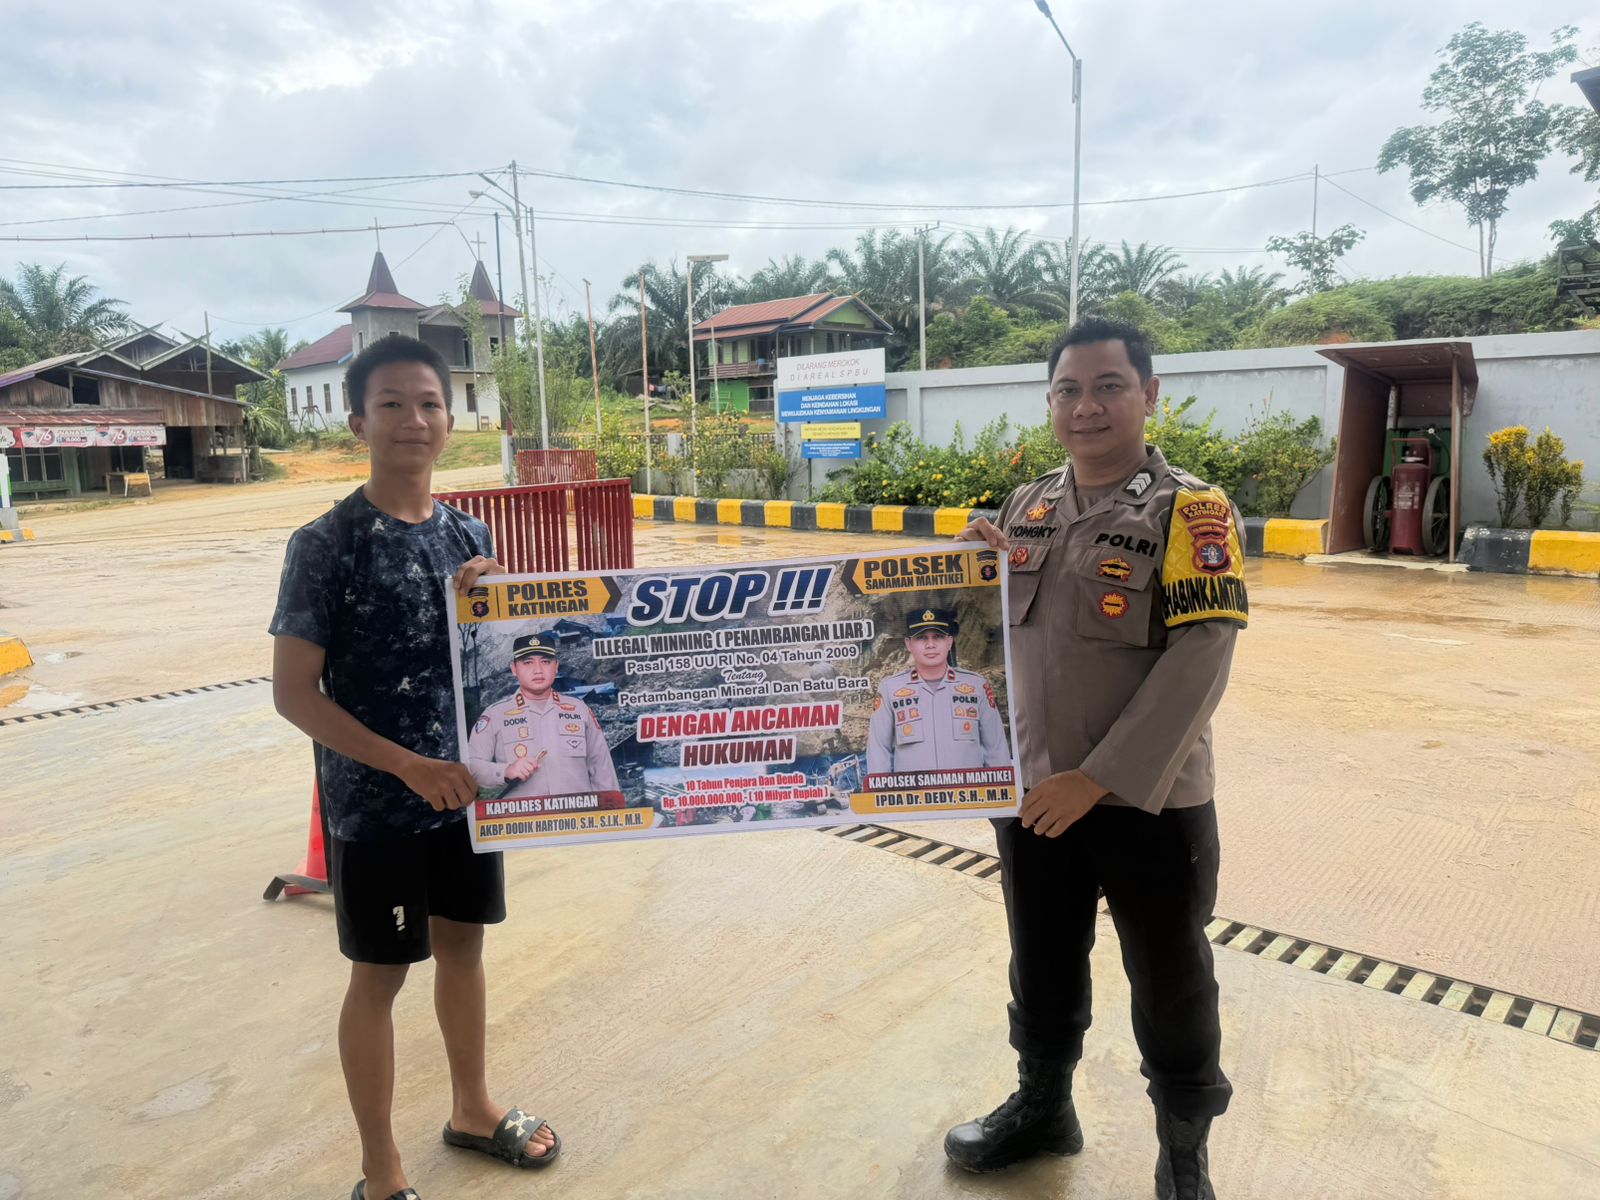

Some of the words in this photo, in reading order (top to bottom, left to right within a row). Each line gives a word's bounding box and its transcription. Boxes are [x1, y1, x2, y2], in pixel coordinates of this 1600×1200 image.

[796, 361, 827, 371] DILARANG
[827, 358, 860, 369] MEROKOK
[802, 371, 836, 380] AREAL
[839, 368, 868, 378] SPBU
[801, 394, 825, 402] MENJAGA
[825, 392, 857, 401] KEBERSIHAN
[848, 406, 881, 414] LINGKUNGAN
[1182, 502, 1226, 515] POLRES
[1009, 525, 1057, 539] YONGKY
[1095, 533, 1158, 558] POLRI
[863, 554, 963, 579] POLSEK
[865, 576, 914, 590] SANAMAN
[916, 572, 964, 587] MANTIKEI
[506, 579, 588, 603] POLRES
[629, 573, 766, 623] STOP
[771, 567, 833, 612] !!!
[508, 599, 590, 617] KATINGAN
[595, 637, 648, 657] ILLEGAL
[650, 632, 713, 653] MINNING
[724, 624, 830, 648] PENAMBANGAN
[832, 622, 864, 640] LIAR
[627, 659, 664, 673] Pasal
[668, 657, 691, 670] 158
[695, 655, 714, 668] UU
[719, 654, 732, 666] RI
[736, 653, 758, 665] No.
[762, 652, 778, 663] 04
[782, 650, 822, 661] Tahun
[826, 646, 857, 659] 2009
[722, 669, 765, 682] Tentang
[620, 689, 717, 705] Pertambangan
[720, 683, 769, 698] Mineral
[773, 682, 799, 693] Dan
[803, 680, 834, 691] Batu
[838, 678, 868, 689] Bara
[952, 695, 978, 704] POLRI
[892, 697, 920, 709] DEDY
[503, 716, 528, 727] DODIK
[558, 712, 582, 720] POLRI
[640, 709, 728, 739] DENGAN
[731, 703, 840, 732] ANCAMAN
[682, 738, 793, 768] HUKUMAN
[686, 781, 695, 791] 10
[696, 780, 722, 790] Tahun
[724, 777, 757, 788] Penjara
[758, 776, 775, 786] Dan
[776, 773, 804, 785] Denda
[868, 775, 916, 789] KAPOLSEK
[917, 772, 964, 786] SANAMAN
[966, 770, 1012, 784] MANTIKEI
[486, 798, 542, 815] KAPOLRES
[544, 794, 599, 811] KATINGAN
[663, 797, 676, 809] Rp.
[764, 789, 791, 802] Milyar
[793, 787, 823, 800] Rupiah
[876, 793, 903, 807] IPDA
[906, 793, 922, 805] Dr.
[924, 790, 956, 804] DEDY,
[958, 789, 984, 803] S.H.,
[986, 788, 1012, 801] M.H.
[480, 824, 504, 837] AKBP
[505, 821, 534, 835] DODIK
[535, 818, 579, 833] HARTONO,
[580, 817, 598, 829] S.H.,
[600, 814, 623, 828] S.I.K.,
[624, 812, 643, 825] M.H.
